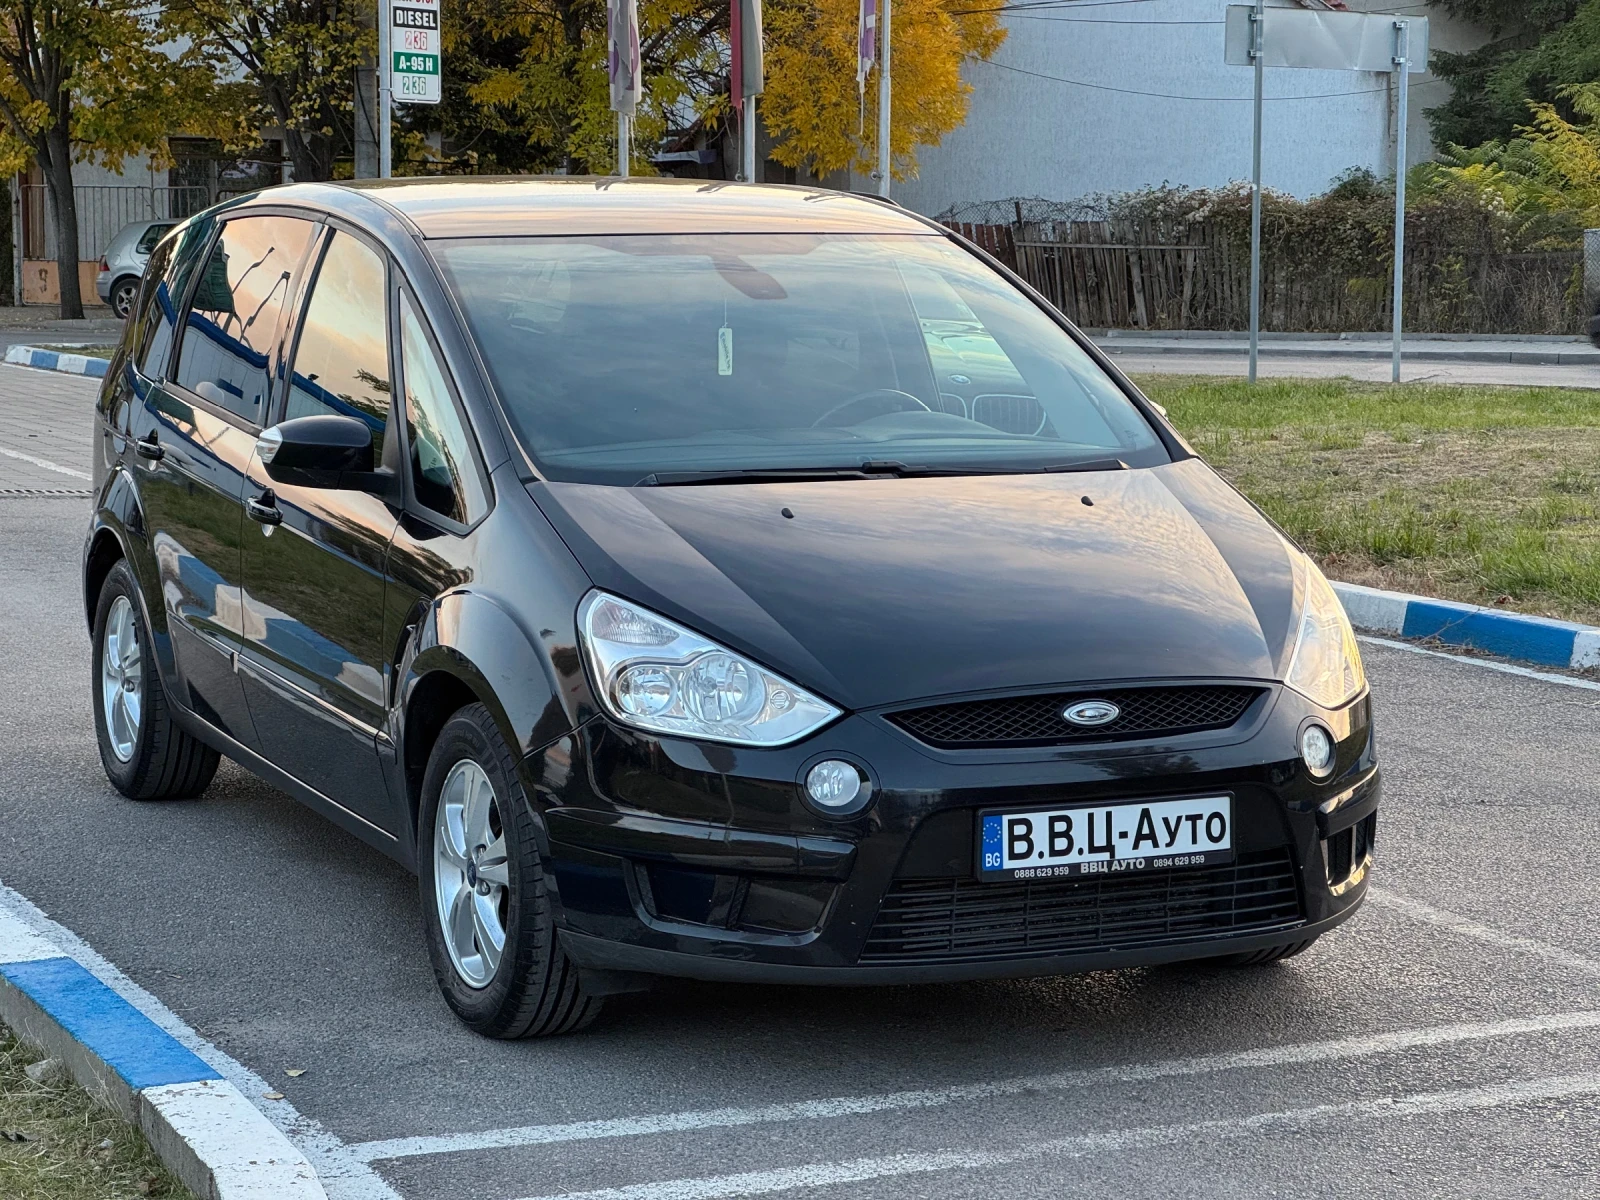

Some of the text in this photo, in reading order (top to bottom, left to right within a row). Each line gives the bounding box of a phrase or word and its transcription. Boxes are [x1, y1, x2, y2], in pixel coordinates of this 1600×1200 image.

[395, 10, 436, 27] DIESEL
[985, 852, 1001, 867] BG
[1014, 855, 1205, 878] 0888 629 959 ВВЦ АУТО 0894 629 959
